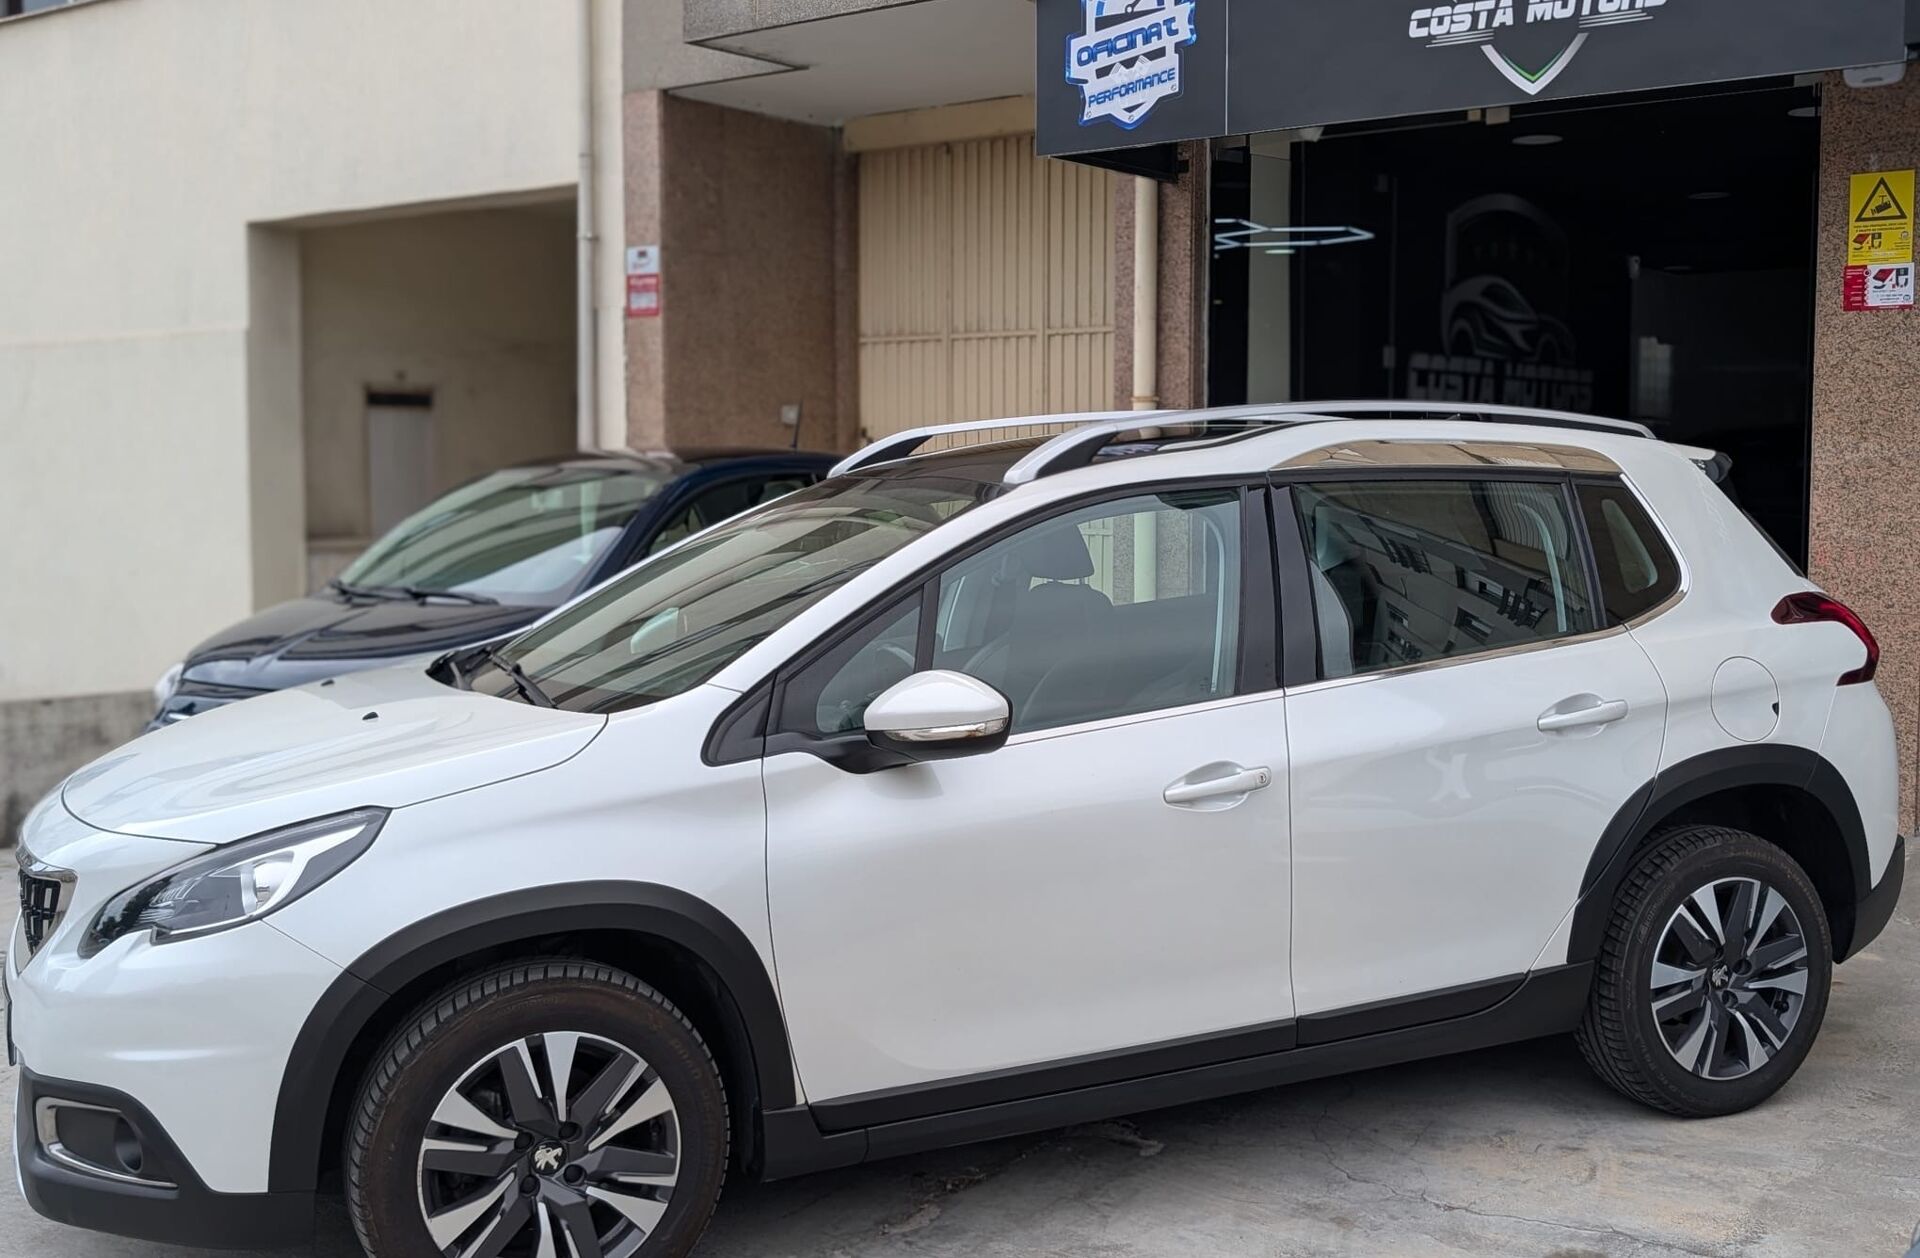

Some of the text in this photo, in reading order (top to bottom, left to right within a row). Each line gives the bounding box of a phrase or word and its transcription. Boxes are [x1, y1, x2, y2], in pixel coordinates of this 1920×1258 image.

[1408, 0, 1667, 38] COSTA MOT
[1088, 67, 1176, 108] PERFORMANCE
